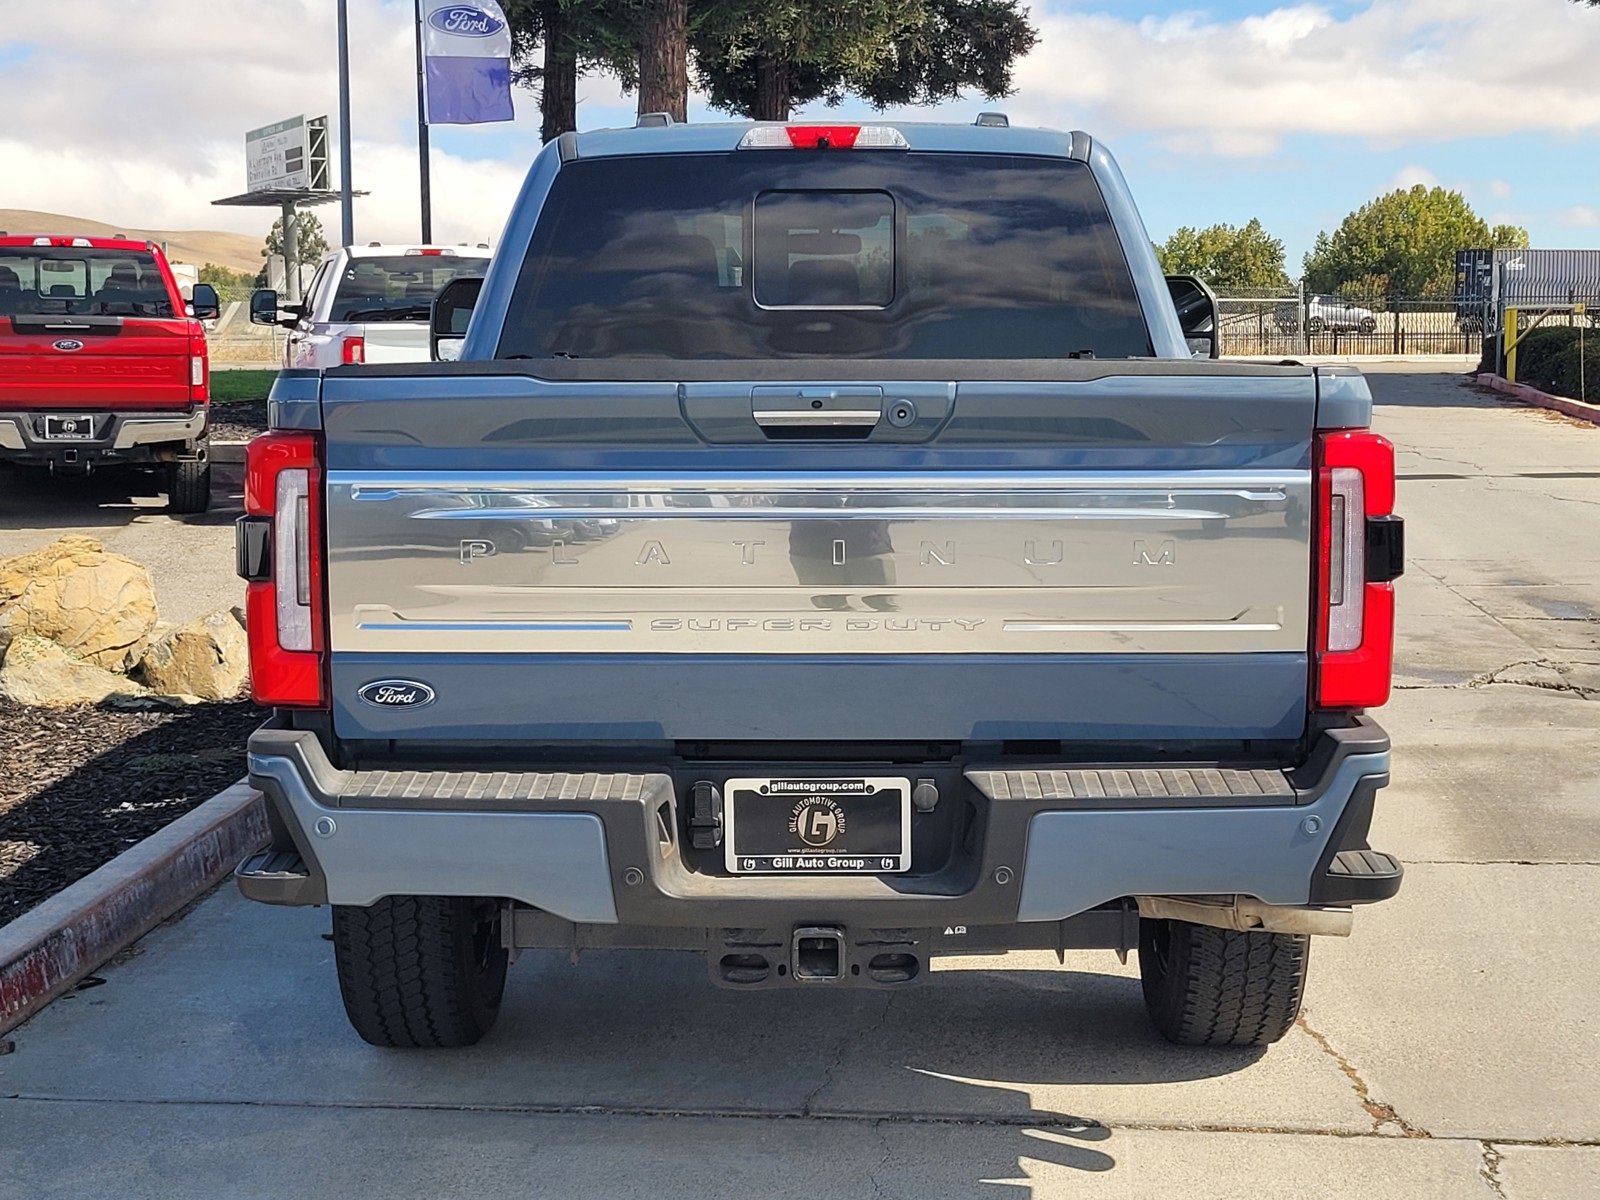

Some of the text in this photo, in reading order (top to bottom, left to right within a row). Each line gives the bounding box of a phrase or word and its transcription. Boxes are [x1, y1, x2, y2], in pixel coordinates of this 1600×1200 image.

[444, 10, 488, 33] Ford
[459, 539, 1176, 566] PLATINUM
[650, 618, 986, 632] SUPER DUTY
[375, 685, 417, 704] Ford
[771, 781, 864, 792] gillautogroup.com
[788, 796, 846, 834] GILL AUTOMOTIVE GROUP
[772, 858, 865, 870] Gill Auto Group
